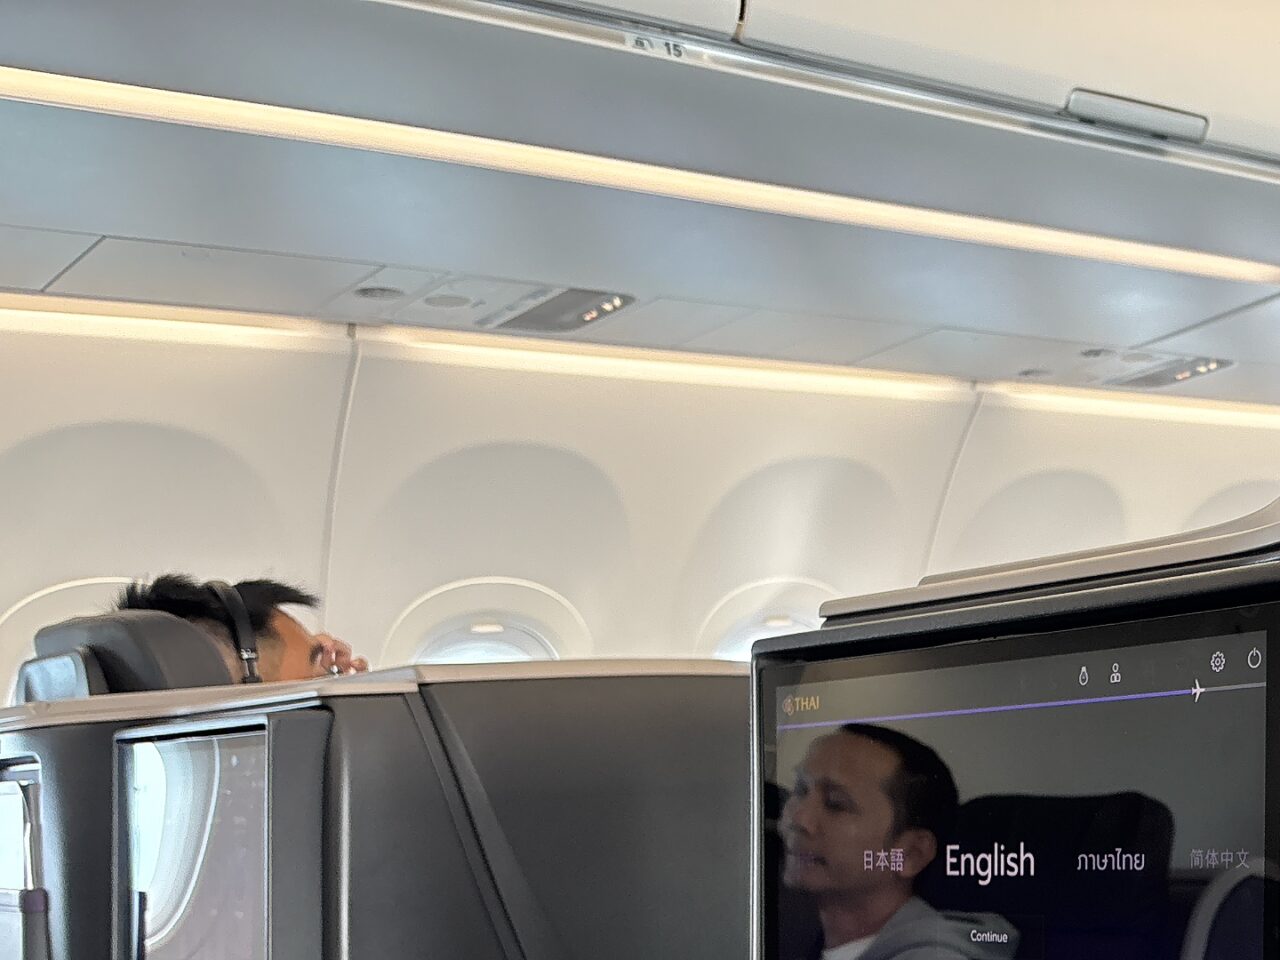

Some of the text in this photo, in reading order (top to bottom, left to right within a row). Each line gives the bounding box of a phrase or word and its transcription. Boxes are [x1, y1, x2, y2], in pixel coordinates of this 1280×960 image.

[664, 41, 683, 58] 15
[795, 695, 820, 711] THAI
[863, 848, 905, 872] 日本語
[946, 841, 1035, 886] English
[1077, 847, 1145, 871] ภาษาไทย
[1190, 848, 1250, 870] 简体中文
[970, 929, 1008, 943] Continue
